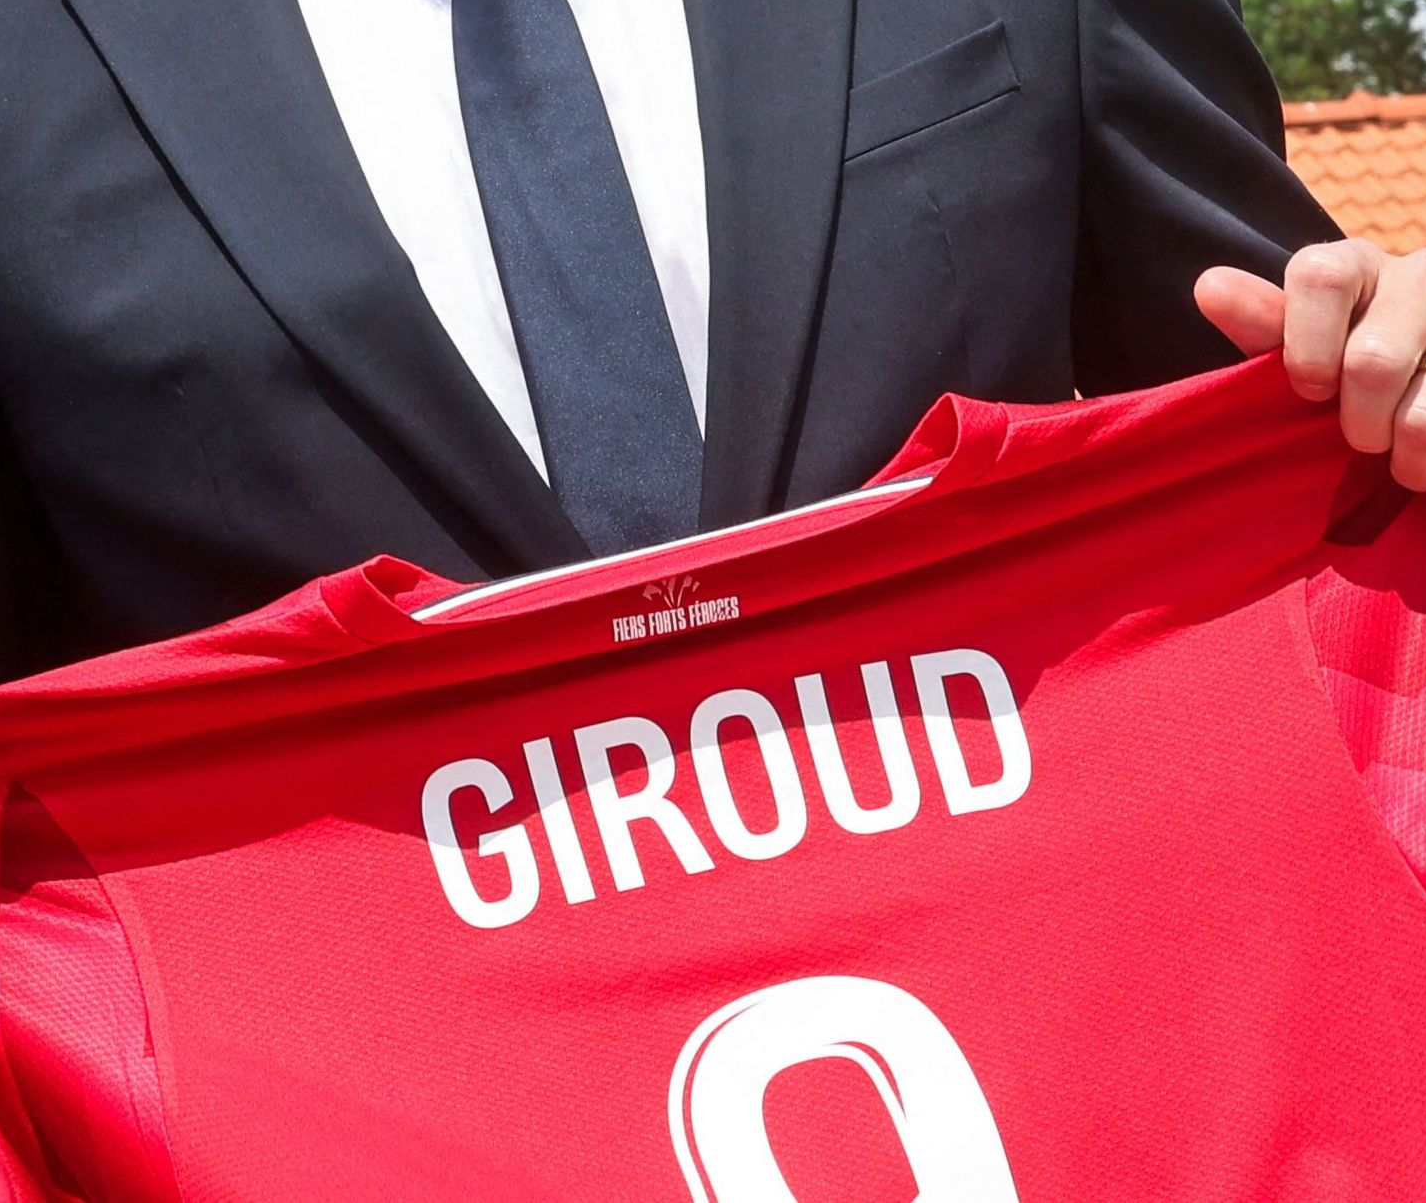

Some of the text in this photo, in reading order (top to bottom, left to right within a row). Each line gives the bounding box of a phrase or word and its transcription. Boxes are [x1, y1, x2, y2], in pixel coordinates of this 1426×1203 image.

[612, 596, 740, 643] FIERS FORTS FÉROCES
[421, 648, 1032, 929] GIROUD
